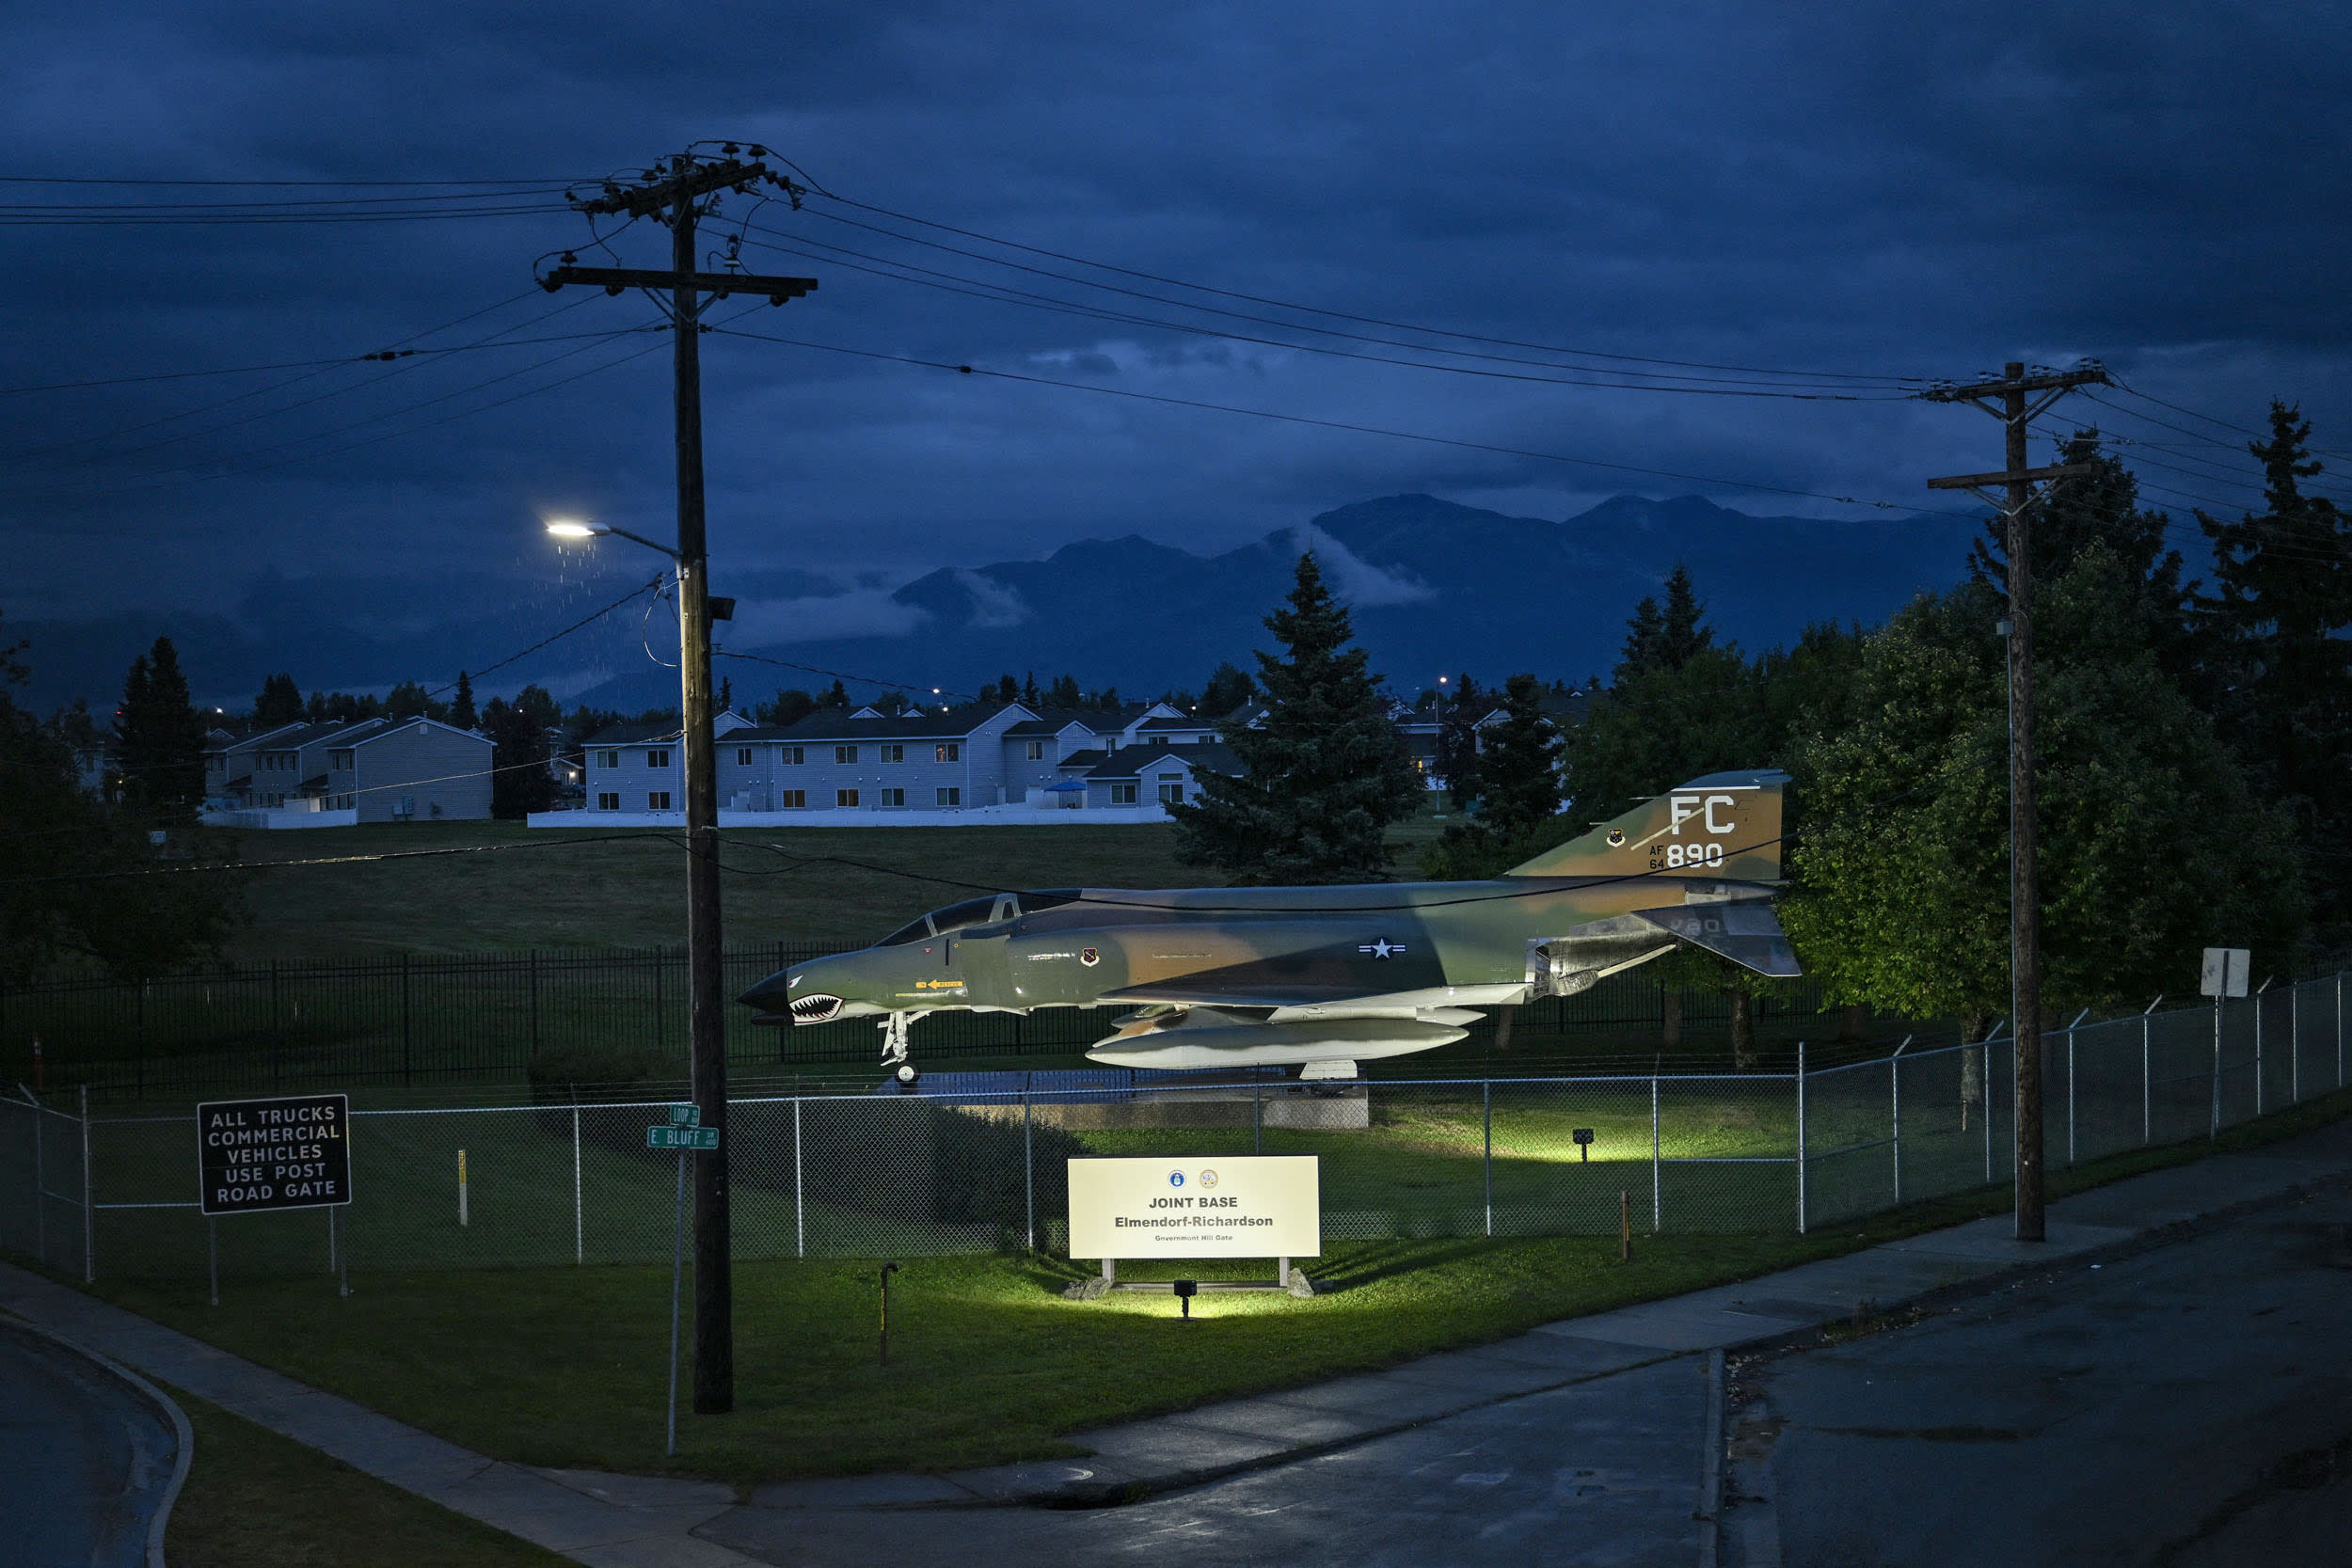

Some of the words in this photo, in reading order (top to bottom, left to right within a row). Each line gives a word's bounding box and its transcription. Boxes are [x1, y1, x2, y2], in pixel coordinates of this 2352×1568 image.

[1670, 795, 1735, 835] FC
[1649, 845, 1664, 856] AF
[1666, 843, 1723, 868] 890
[1649, 859, 1664, 869] 64
[211, 1112, 246, 1128] ALL
[258, 1106, 335, 1125] TRUCKS
[674, 1107, 689, 1123] LOOP
[208, 1124, 340, 1147] COMMERCIAL
[667, 1130, 700, 1145] BLUFF
[228, 1144, 323, 1164] VEHICLES
[226, 1167, 263, 1183] USE
[275, 1163, 326, 1180] POST
[217, 1185, 273, 1203] ROAD
[285, 1180, 337, 1197] GATE
[1149, 1197, 1194, 1209] JOINT
[1199, 1196, 1238, 1208] BASE
[1115, 1215, 1274, 1227] Elmendorf-Richardson
